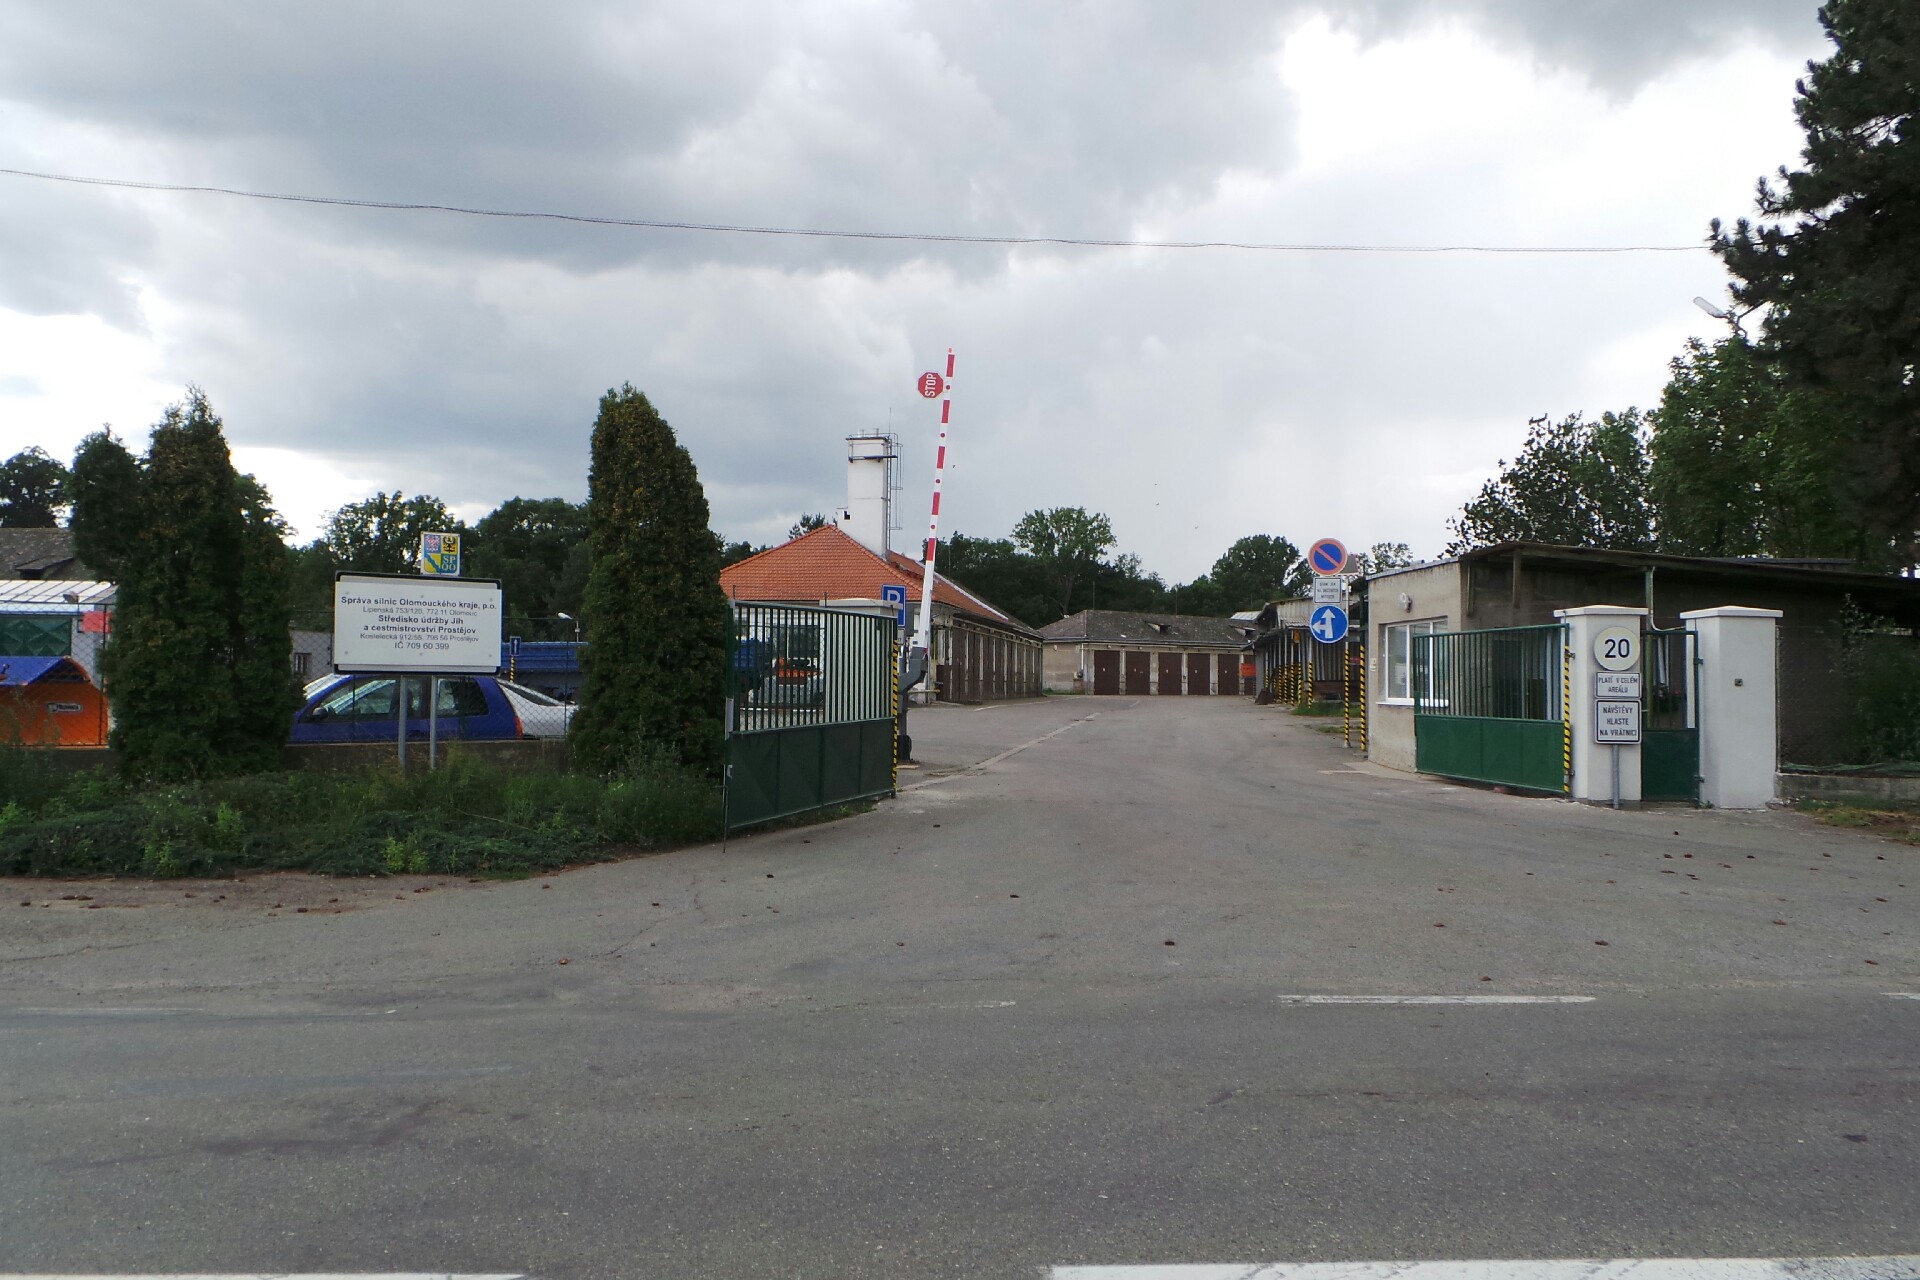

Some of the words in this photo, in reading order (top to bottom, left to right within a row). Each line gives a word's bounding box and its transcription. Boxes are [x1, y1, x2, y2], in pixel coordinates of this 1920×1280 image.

[924, 373, 937, 397] STOP
[341, 596, 372, 605] Správa
[399, 598, 457, 608] Olomouckého
[459, 601, 481, 610] kraje,
[378, 614, 419, 623] Středisko
[421, 616, 449, 625] údržby
[450, 617, 464, 625] Jih
[438, 626, 476, 635] Prostějov
[360, 632, 398, 640] Kostelecká
[449, 634, 479, 643] Prostějov
[394, 641, 404, 649] IČ
[406, 642, 421, 650] 709
[422, 642, 433, 650] 60
[1604, 638, 1630, 659] 20
[1598, 675, 1613, 684] PLATÍ
[1620, 675, 1638, 684] CELÉM
[1608, 684, 1628, 693] AREÁLU
[1602, 704, 1633, 714] NÁVŠTĚVY
[1606, 717, 1629, 726] HLASTE
[1610, 728, 1637, 737] VRÁTNICI
